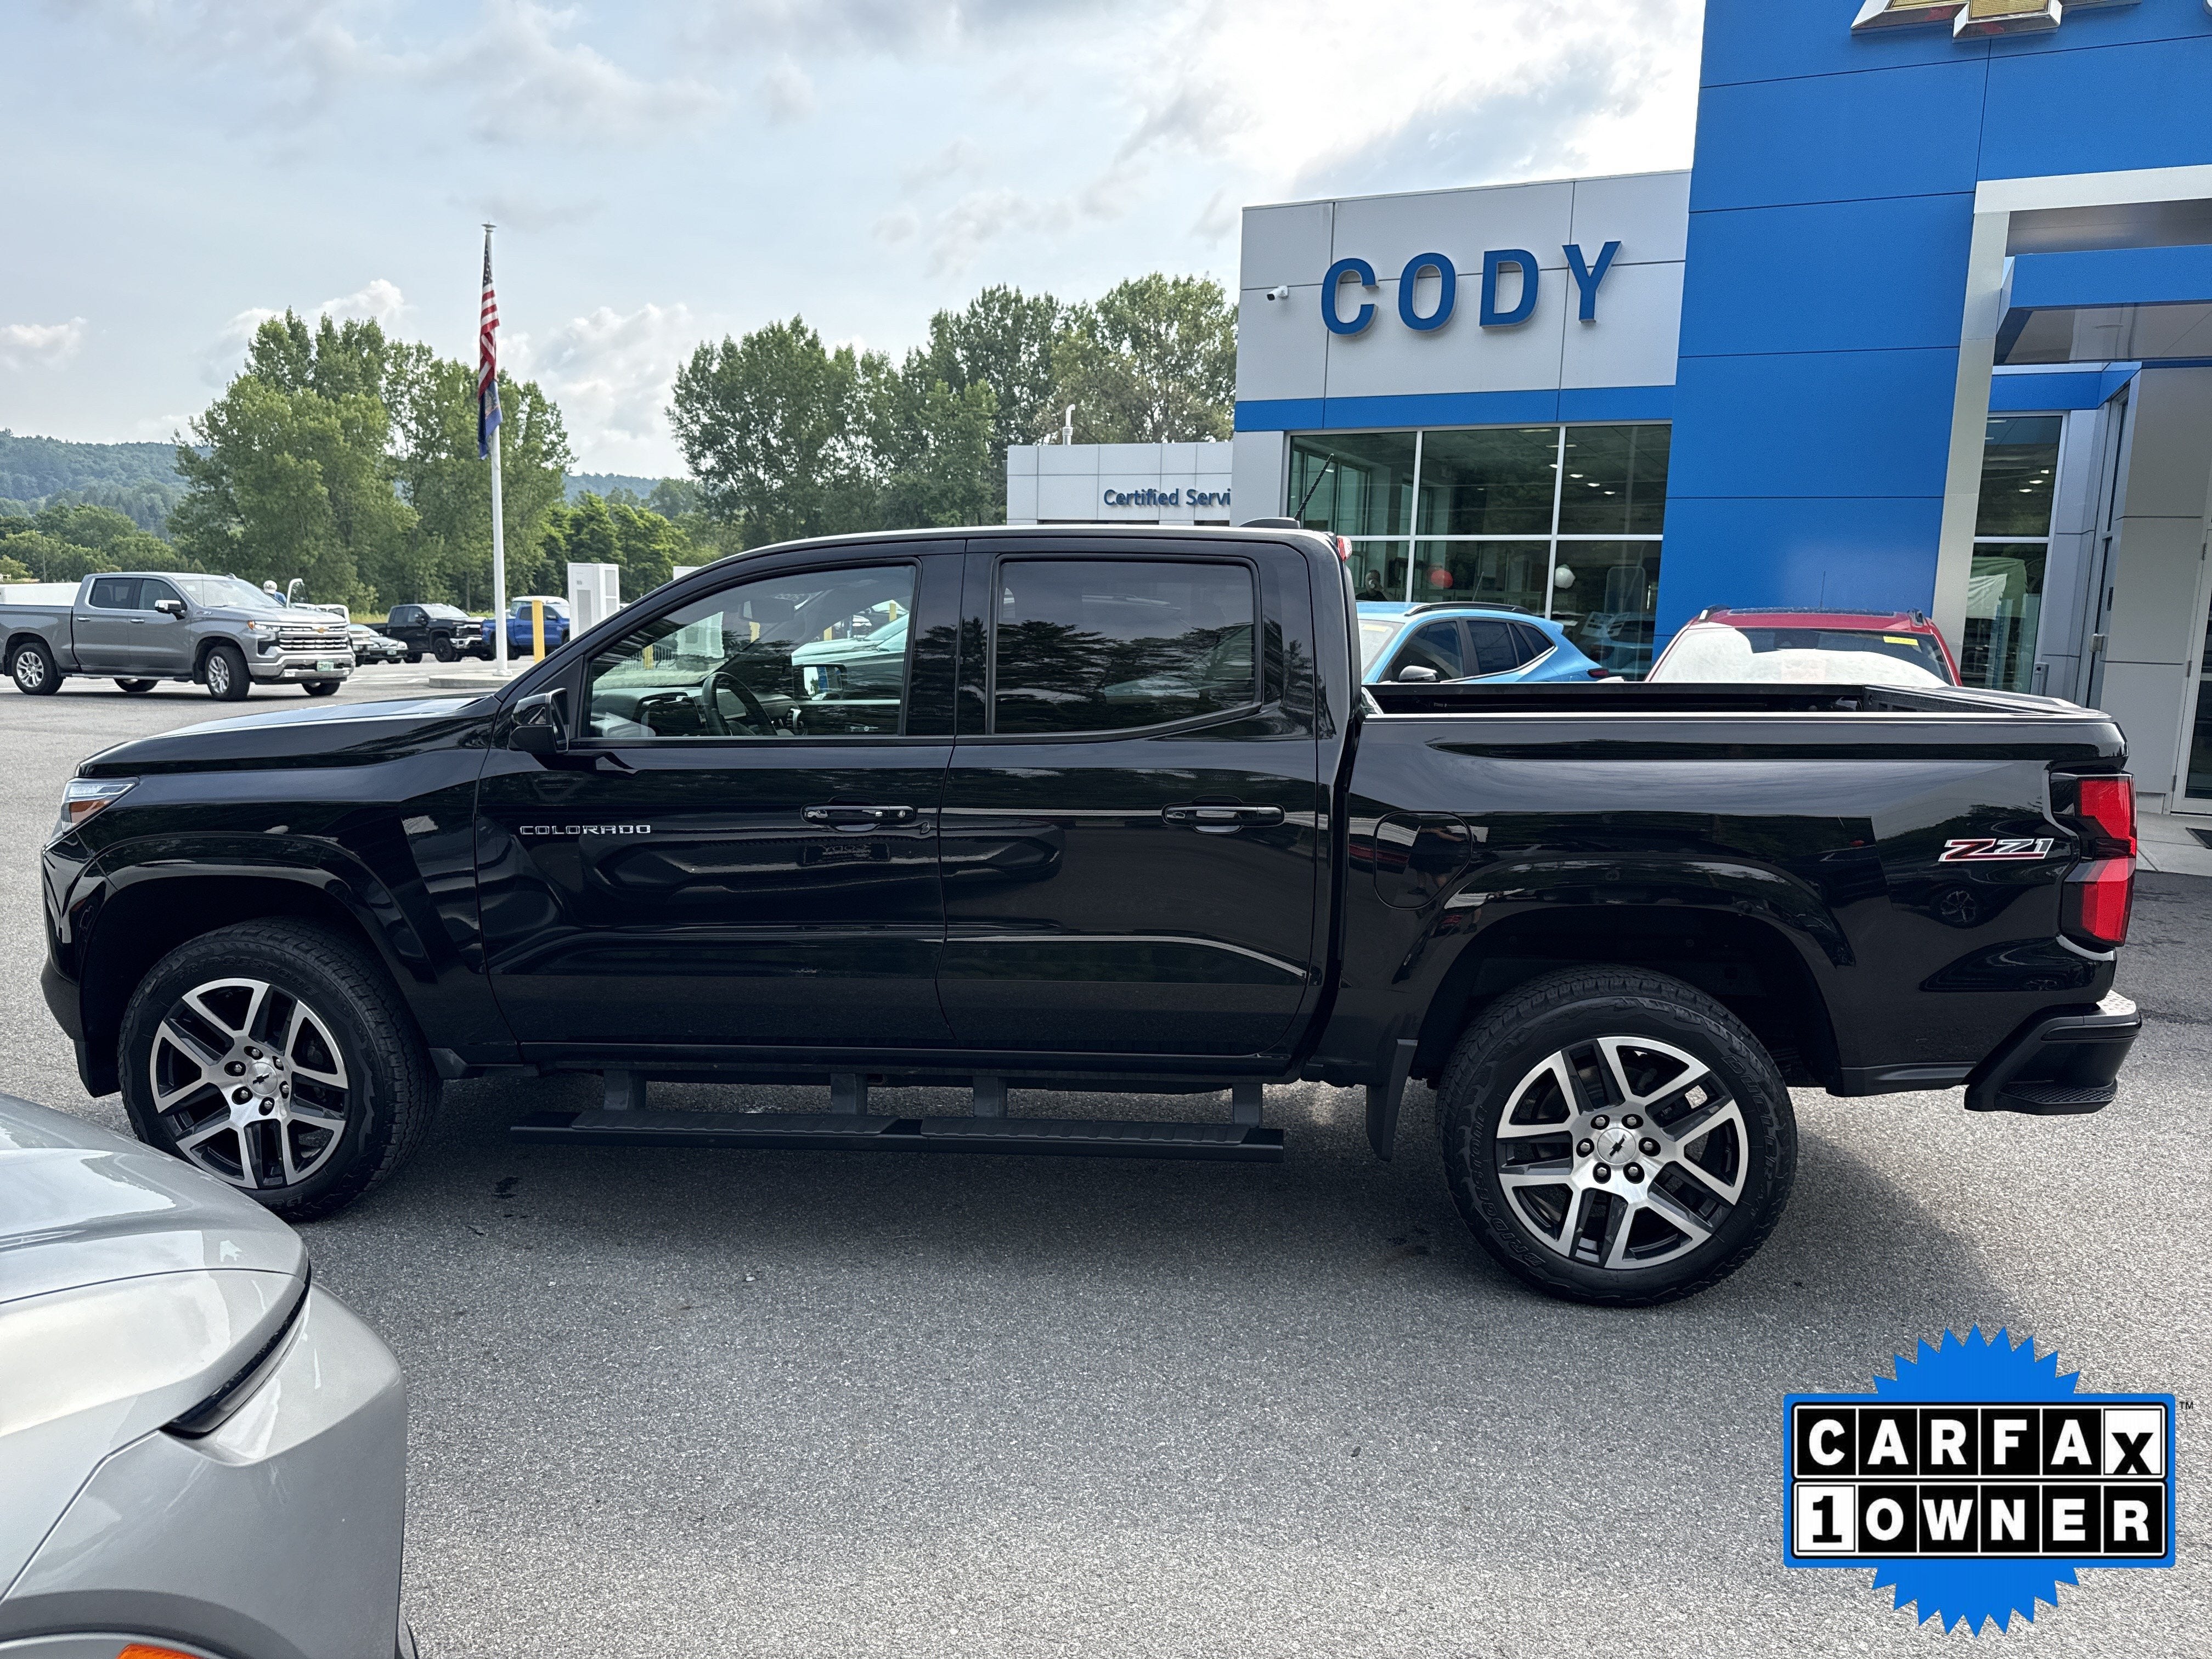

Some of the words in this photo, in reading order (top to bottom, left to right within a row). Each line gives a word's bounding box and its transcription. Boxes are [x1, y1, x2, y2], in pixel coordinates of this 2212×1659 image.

[1321, 240, 1622, 336] CODY
[1103, 488, 1180, 507] Certified
[520, 824, 651, 835] COLORADO
[1938, 838, 2055, 862] Z71
